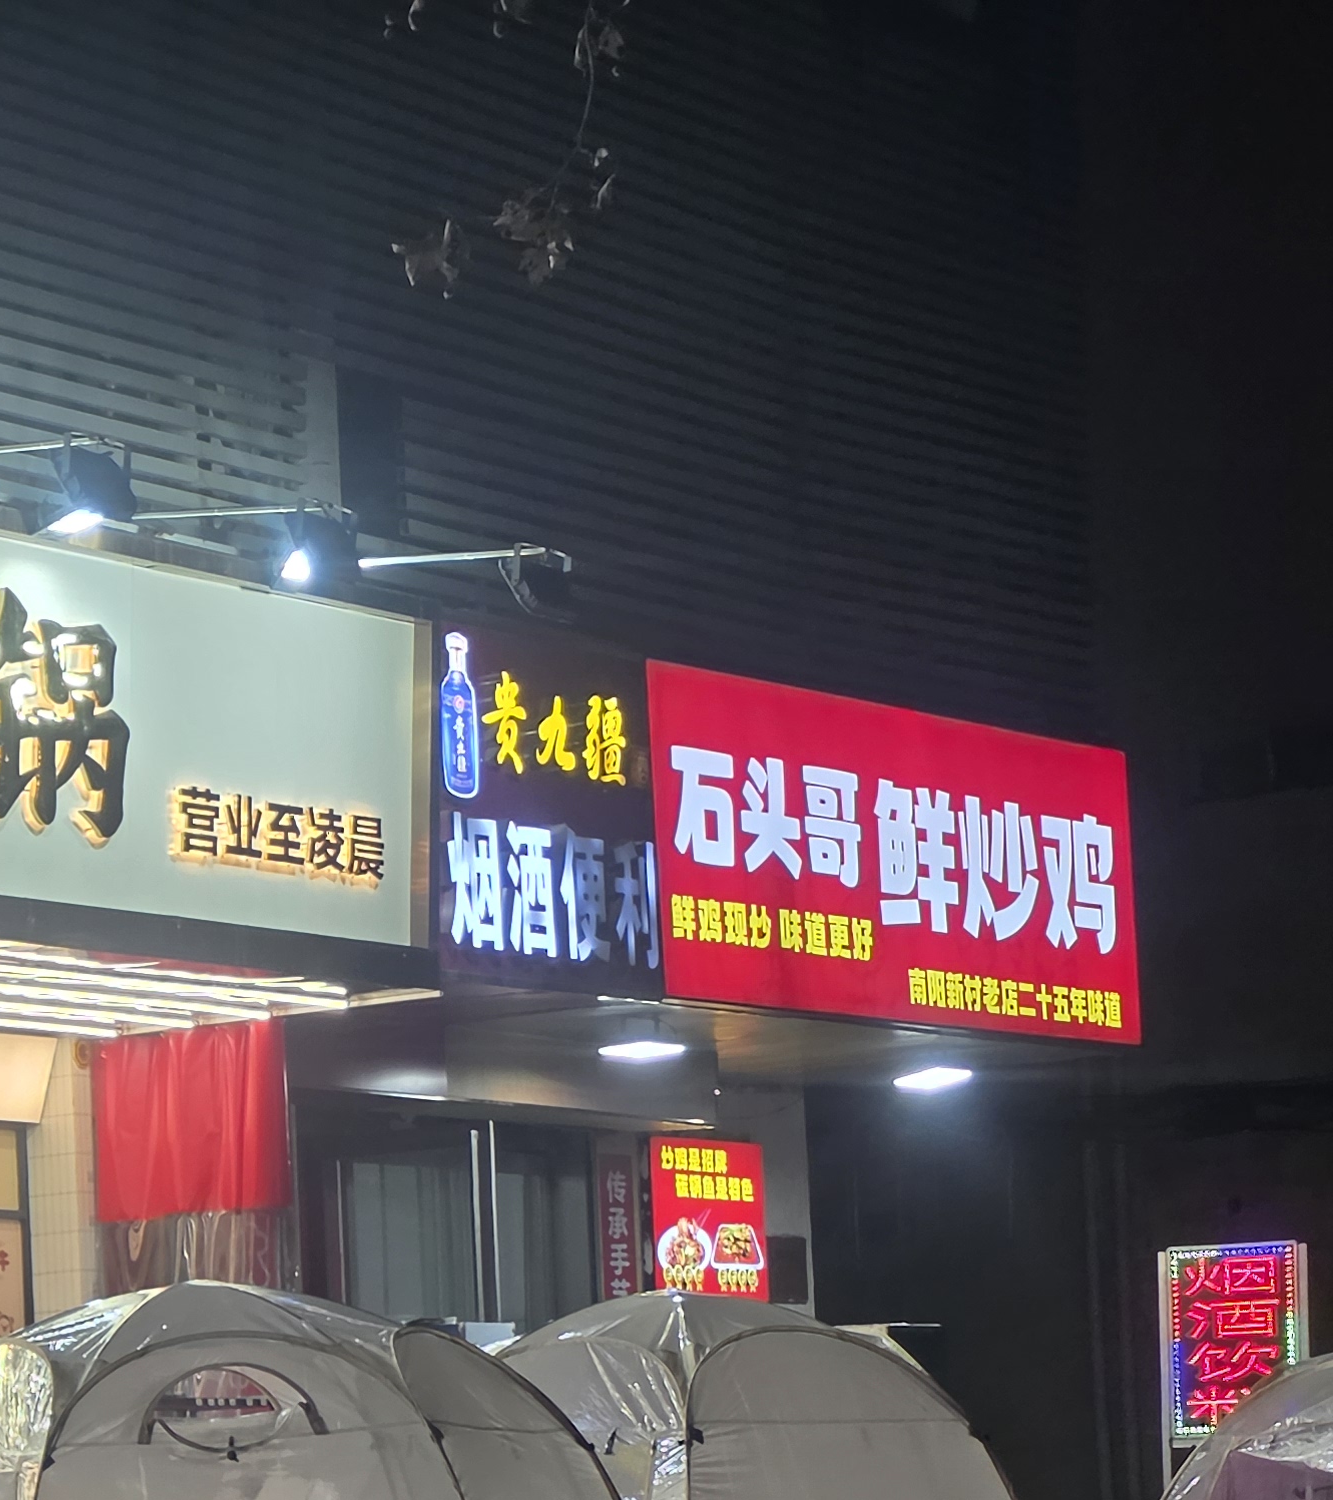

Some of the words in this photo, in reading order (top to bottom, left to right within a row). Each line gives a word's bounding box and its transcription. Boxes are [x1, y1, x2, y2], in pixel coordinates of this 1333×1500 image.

[171, 784, 387, 886] 营业至凌晨
[669, 744, 862, 889] 石头哥
[874, 778, 1117, 955] 鲜炒鸡
[446, 811, 659, 970] 烟酒便利
[670, 893, 773, 951] 鲜鸡现炒
[779, 907, 875, 962] 味道更好
[907, 968, 1123, 1030] 南阳新村老店二十五年味道
